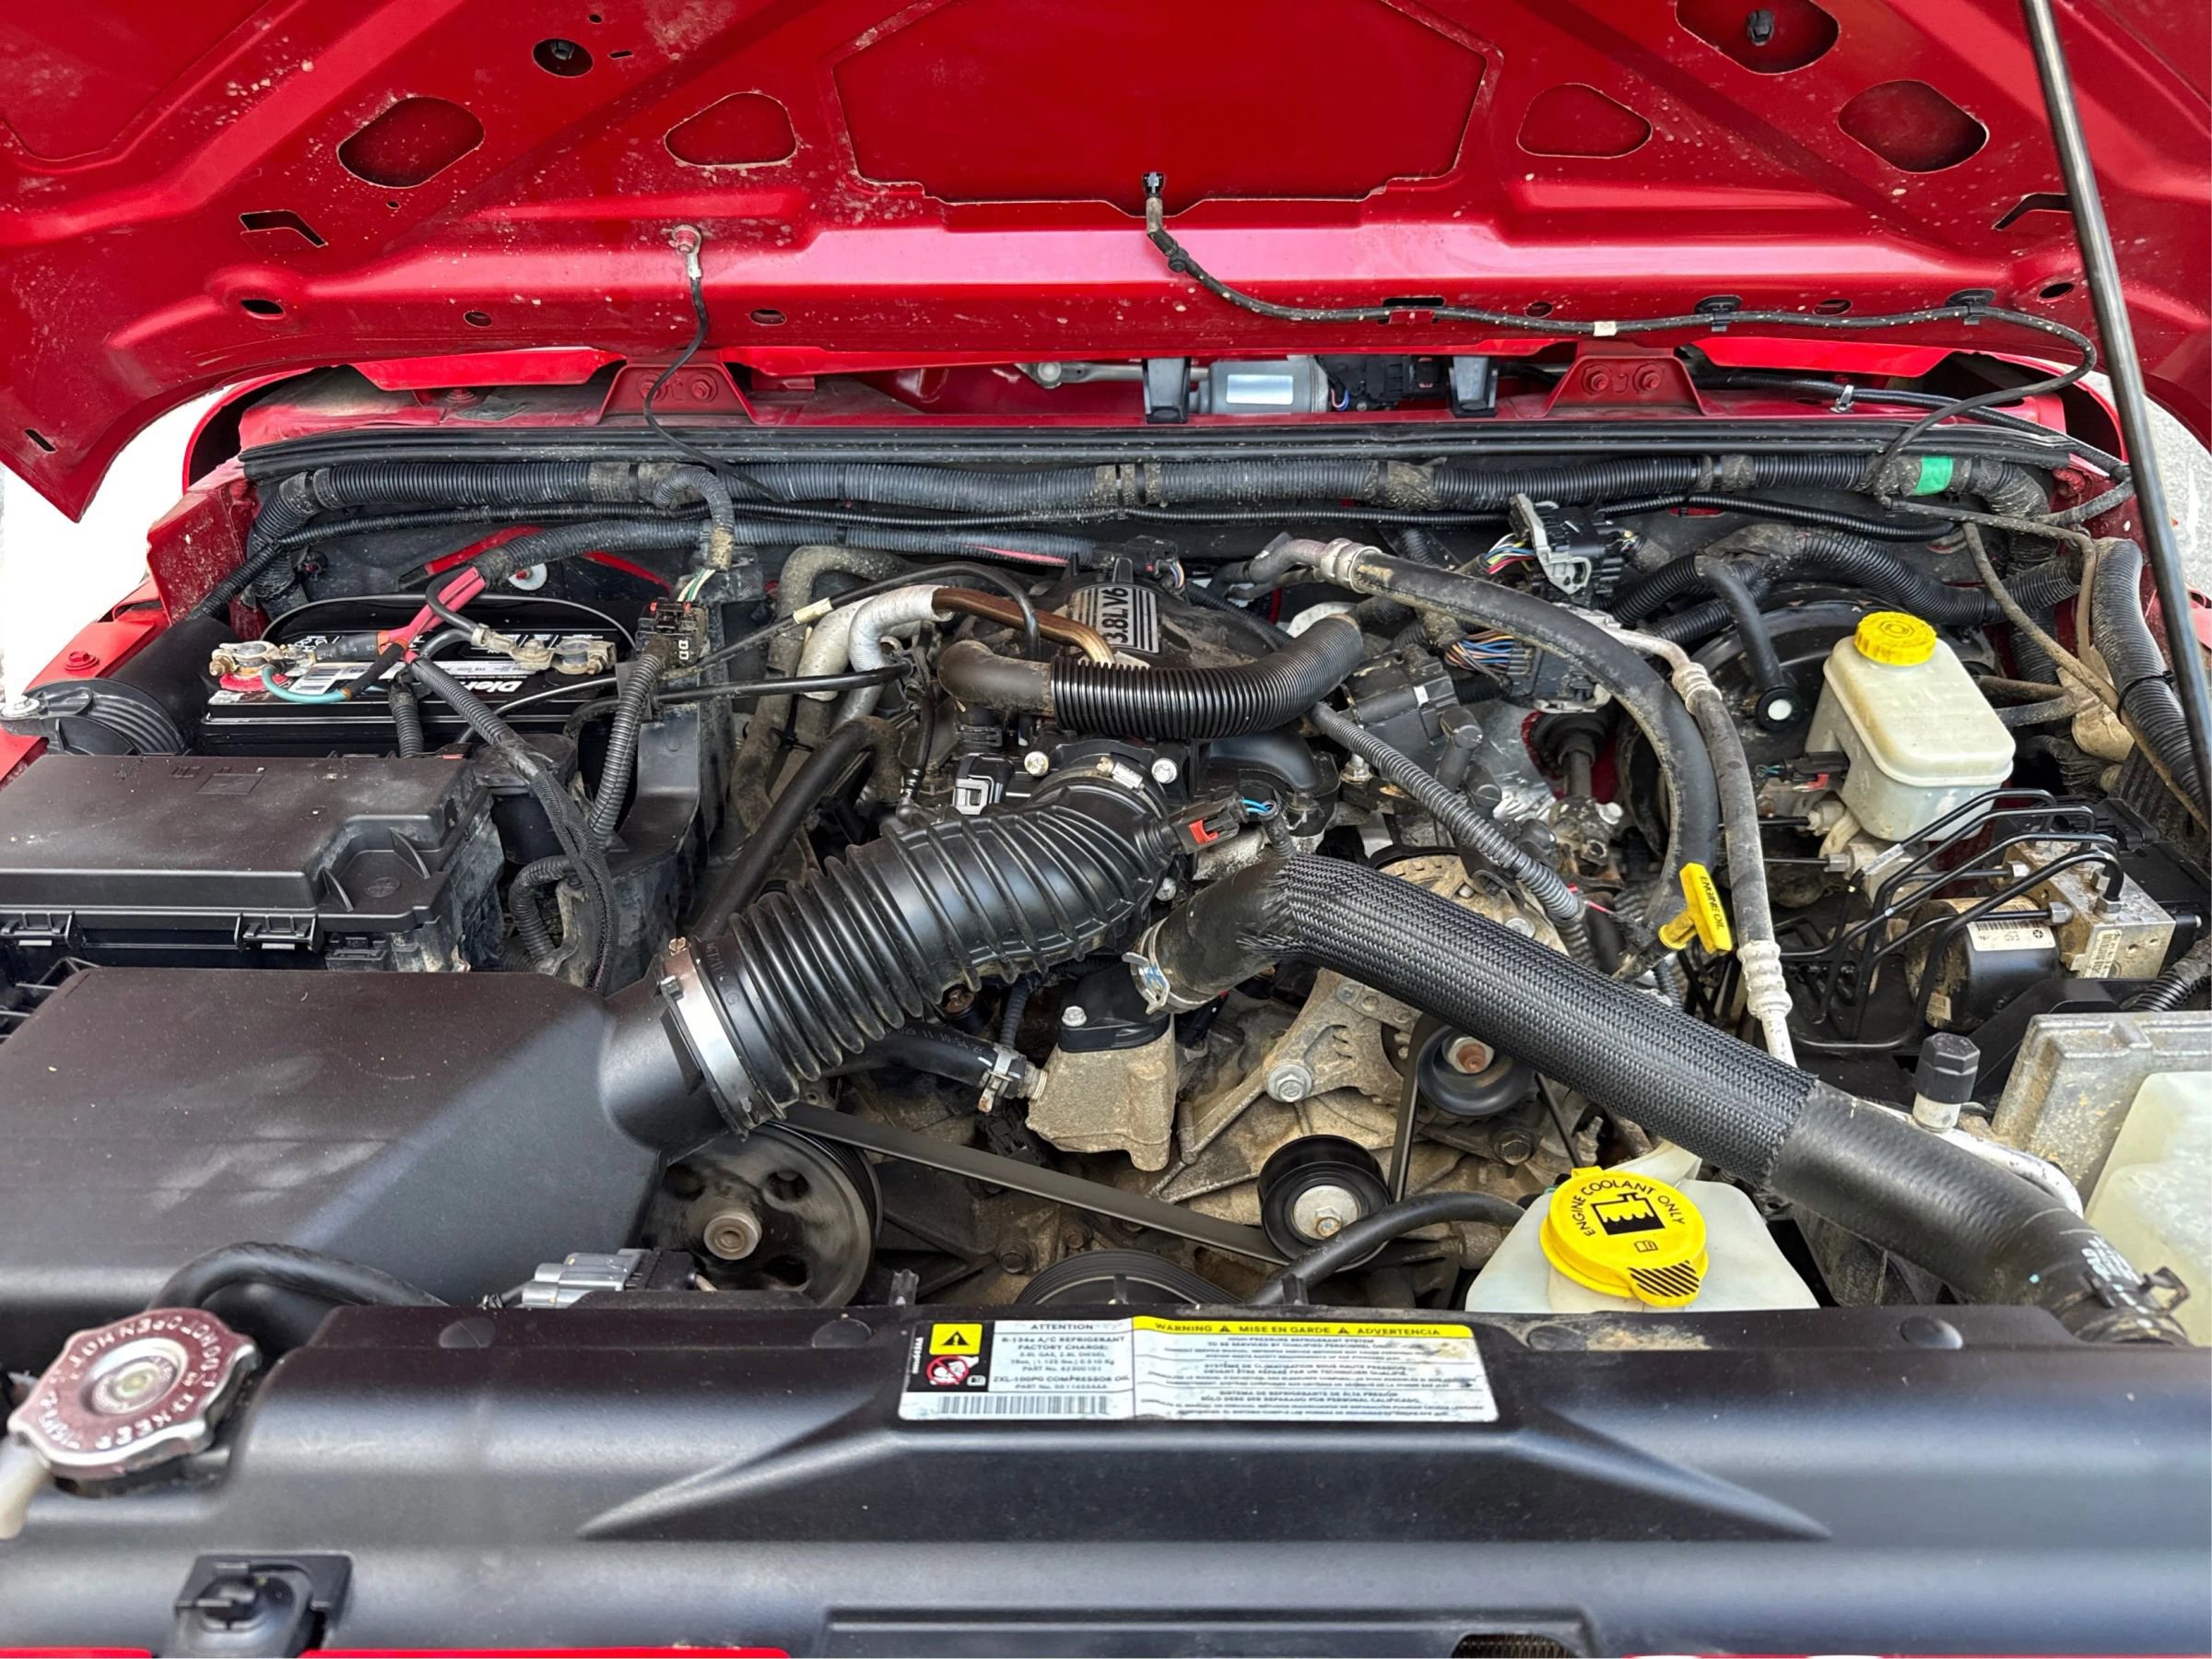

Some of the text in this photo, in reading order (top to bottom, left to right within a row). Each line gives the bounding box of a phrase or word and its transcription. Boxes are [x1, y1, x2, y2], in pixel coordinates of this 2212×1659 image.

[1699, 877, 1724, 931] ENGINE OIL
[1571, 1180, 1686, 1237] ENGINE COOLANT ONLY
[1155, 1323, 1212, 1332] WARNING
[1357, 1327, 1440, 1335] ADVERTENCIA
